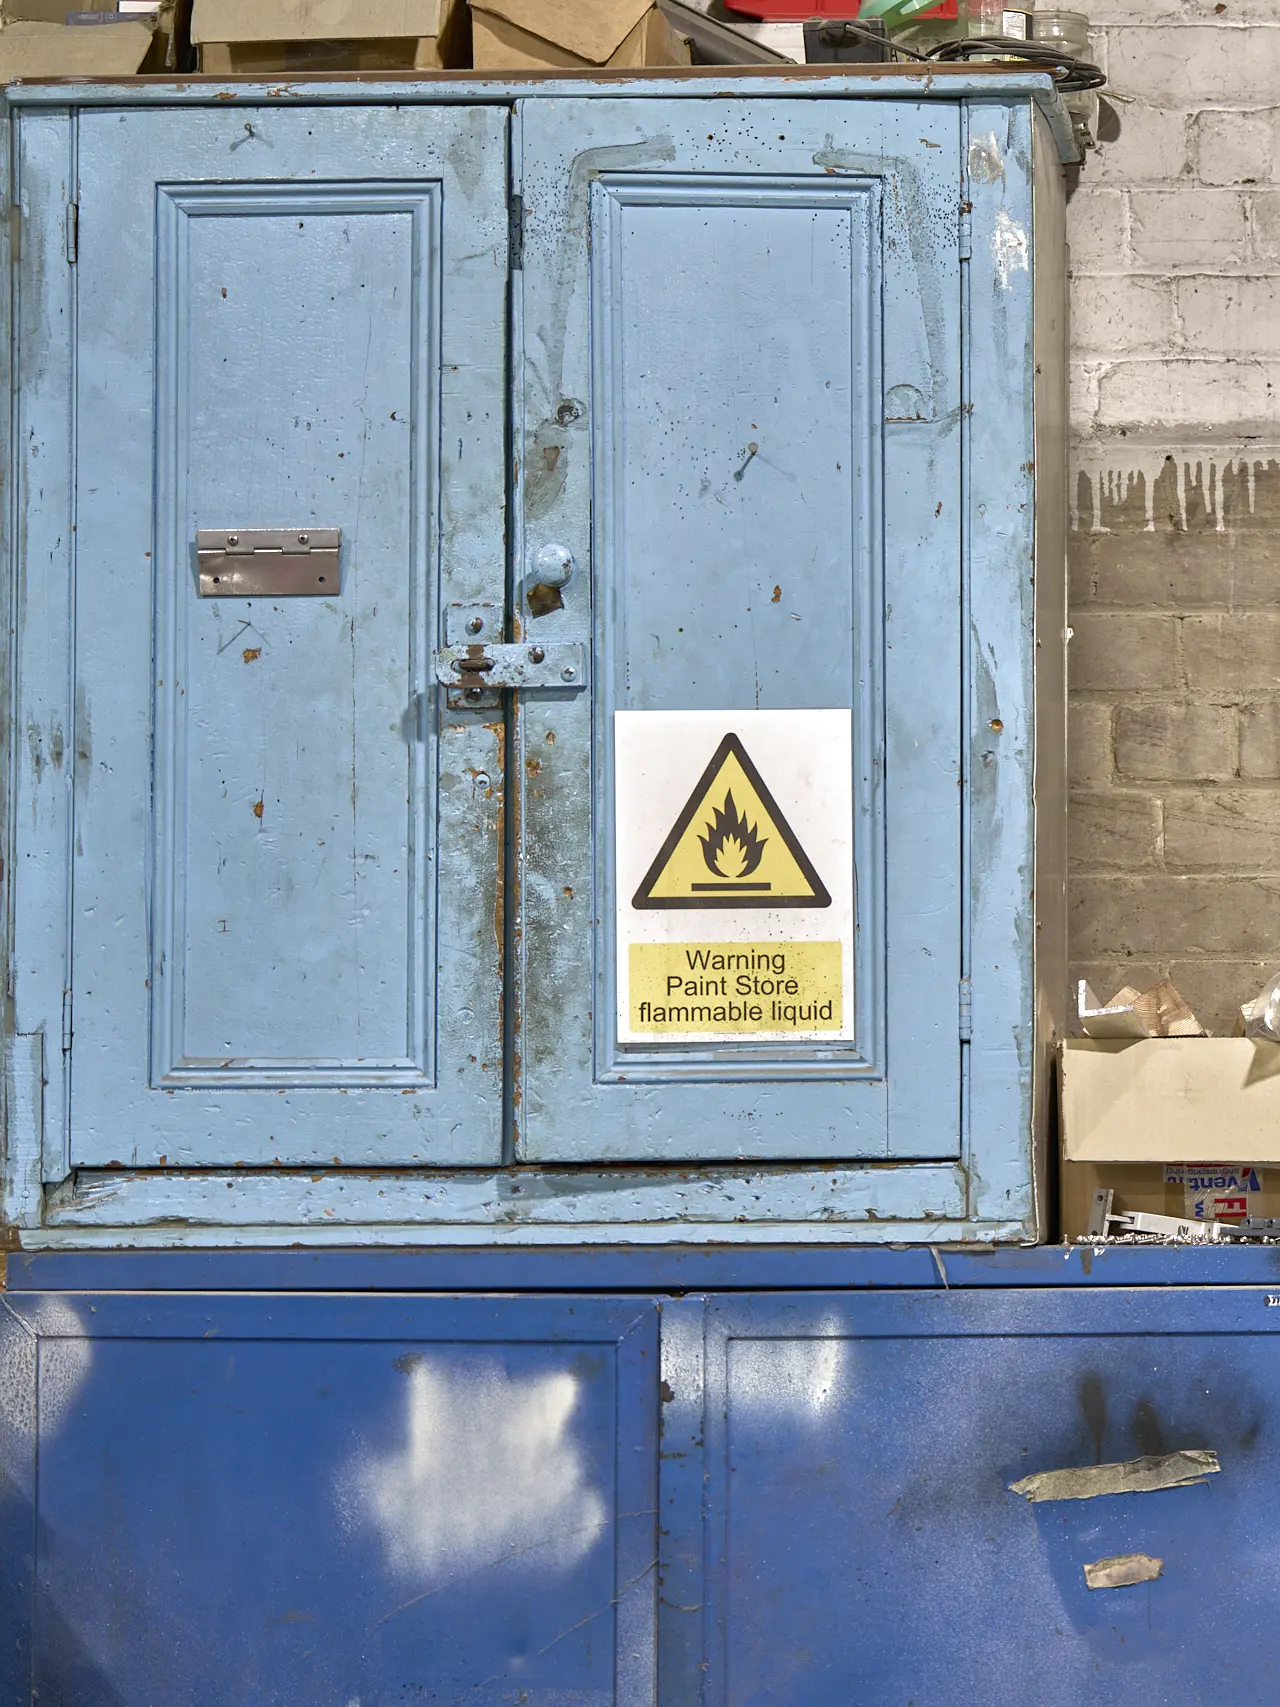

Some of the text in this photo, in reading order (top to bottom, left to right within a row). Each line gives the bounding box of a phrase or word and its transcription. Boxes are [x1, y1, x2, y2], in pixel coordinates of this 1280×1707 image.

[686, 949, 785, 974] Warning
[667, 975, 798, 996] Paint Store
[639, 1000, 832, 1025] flammable liquid
